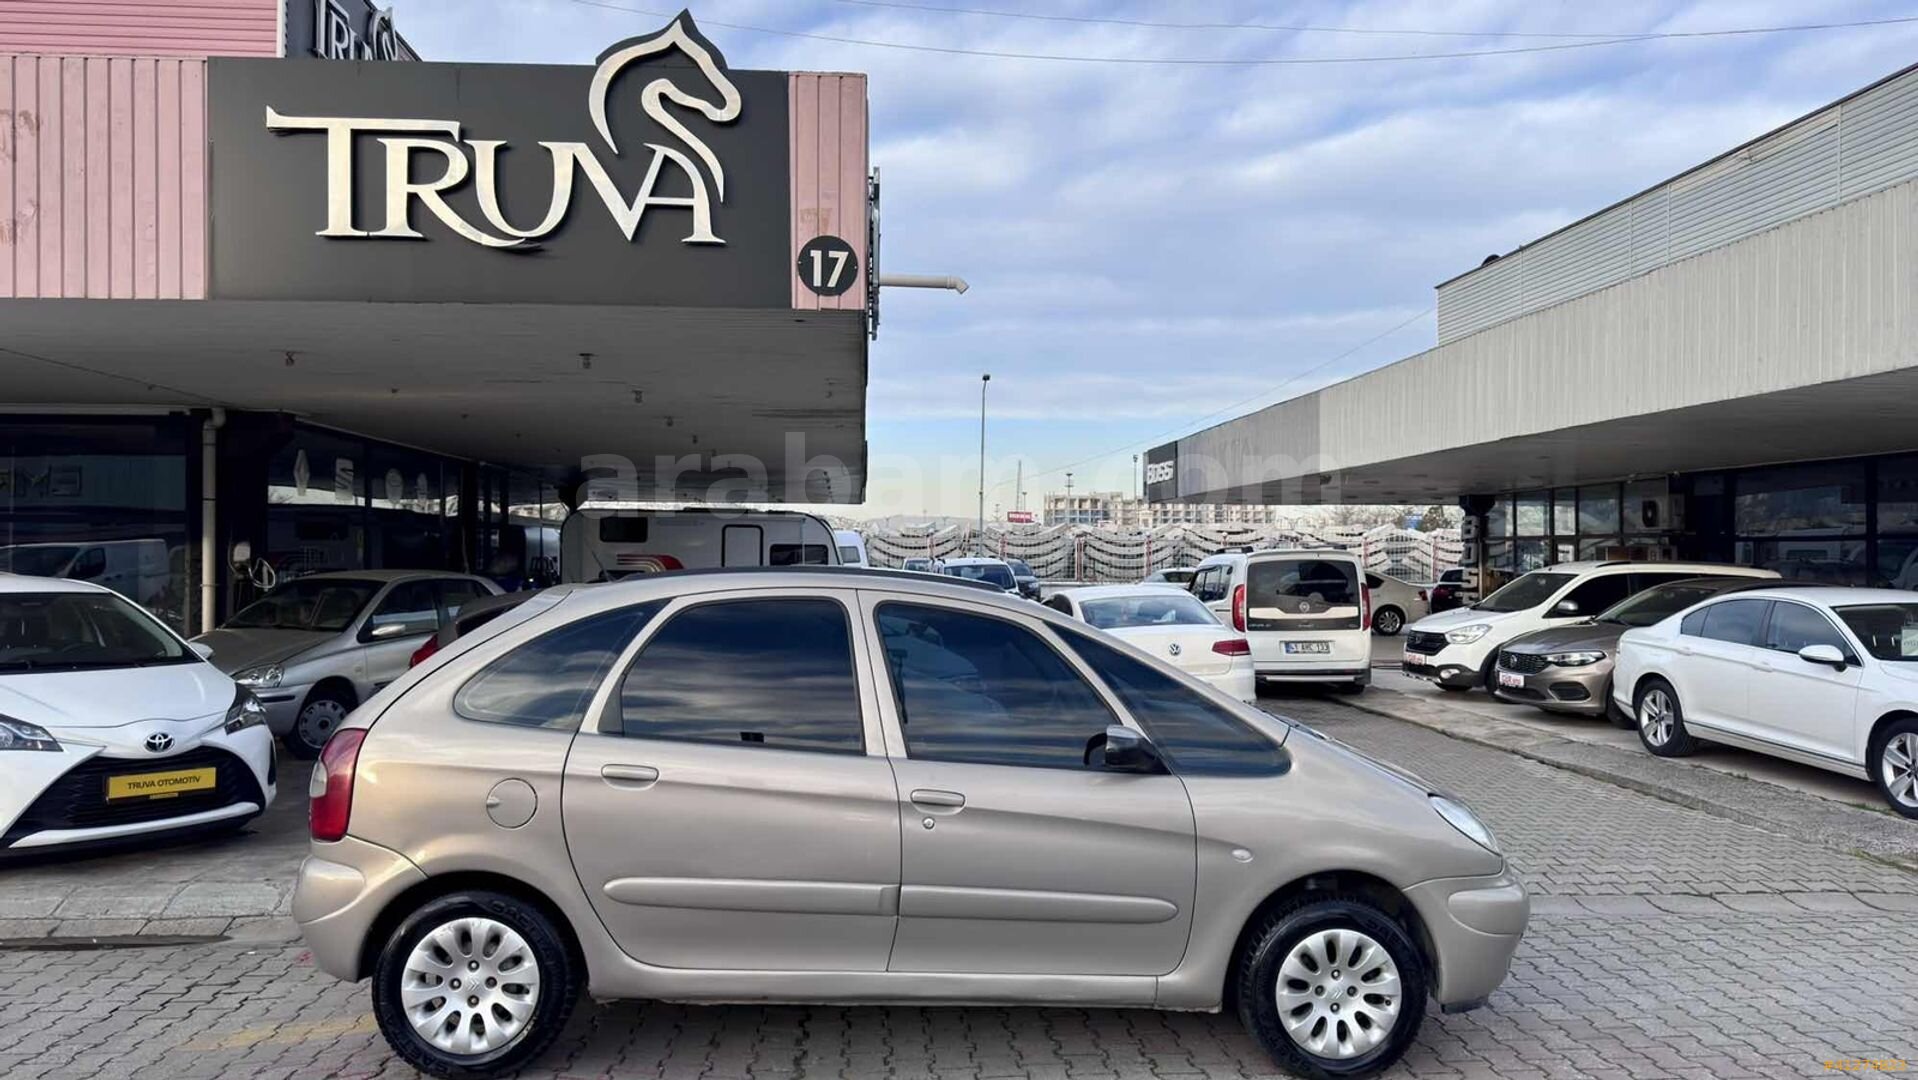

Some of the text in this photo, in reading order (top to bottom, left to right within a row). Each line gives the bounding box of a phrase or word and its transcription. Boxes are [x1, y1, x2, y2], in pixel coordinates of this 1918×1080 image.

[265, 106, 727, 250] TRUVA
[810, 250, 849, 288] 17
[127, 781, 156, 790] TRUVA
